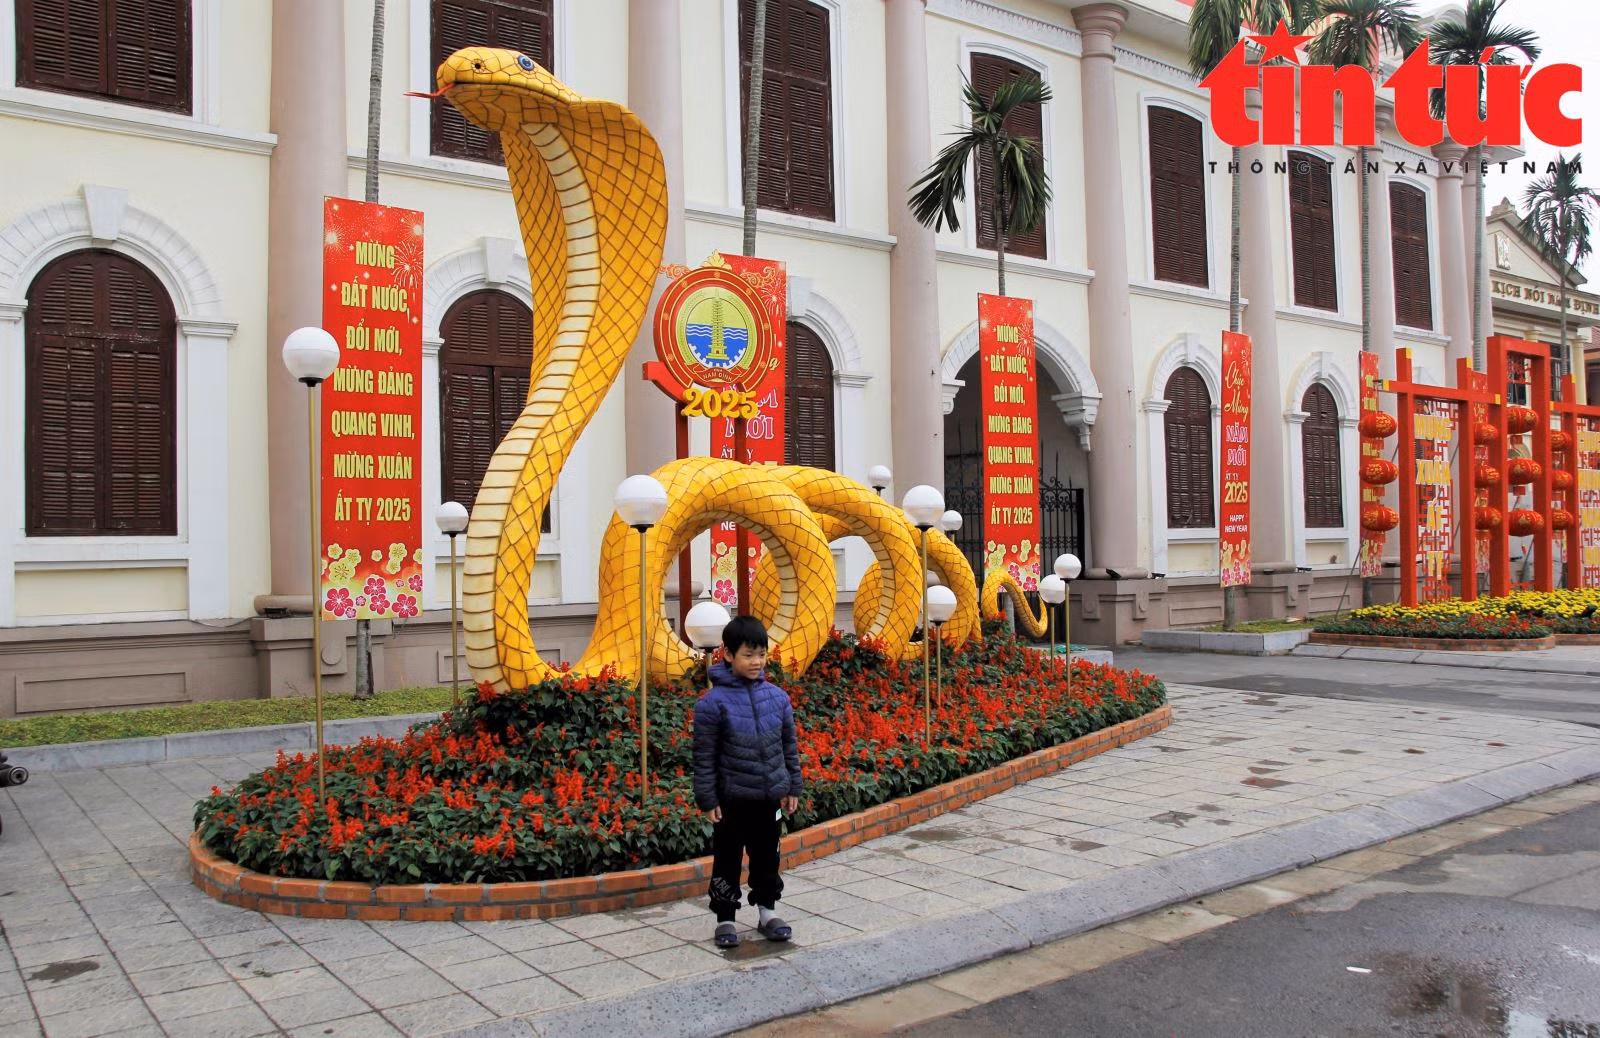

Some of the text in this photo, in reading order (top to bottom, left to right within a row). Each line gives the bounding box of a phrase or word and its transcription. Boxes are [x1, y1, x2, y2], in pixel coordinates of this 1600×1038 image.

[355, 239, 395, 269] MỪNG
[341, 275, 368, 307] ĐẤT
[346, 318, 402, 356] ĐỔI MỚI,
[997, 323, 1019, 344] MỪNG
[990, 349, 1005, 372] ĐẤT
[333, 365, 413, 396] MỪNG ĐẢNG
[681, 387, 758, 419] 2025
[331, 410, 415, 440] QUANG VINH,
[988, 413, 1011, 433] MỪNG
[333, 451, 412, 479] MỪNG XUÂN
[988, 446, 1013, 465] QUANG
[990, 474, 1033, 494] MỪNG XUÂN
[1224, 481, 1248, 503] 2025
[335, 489, 411, 525] ẤT TỴ 2025
[1014, 507, 1033, 525] 2025
[1229, 514, 1245, 522] HAPPY
[720, 520, 737, 531] NE
[1224, 524, 1248, 533] NEW YEAR
